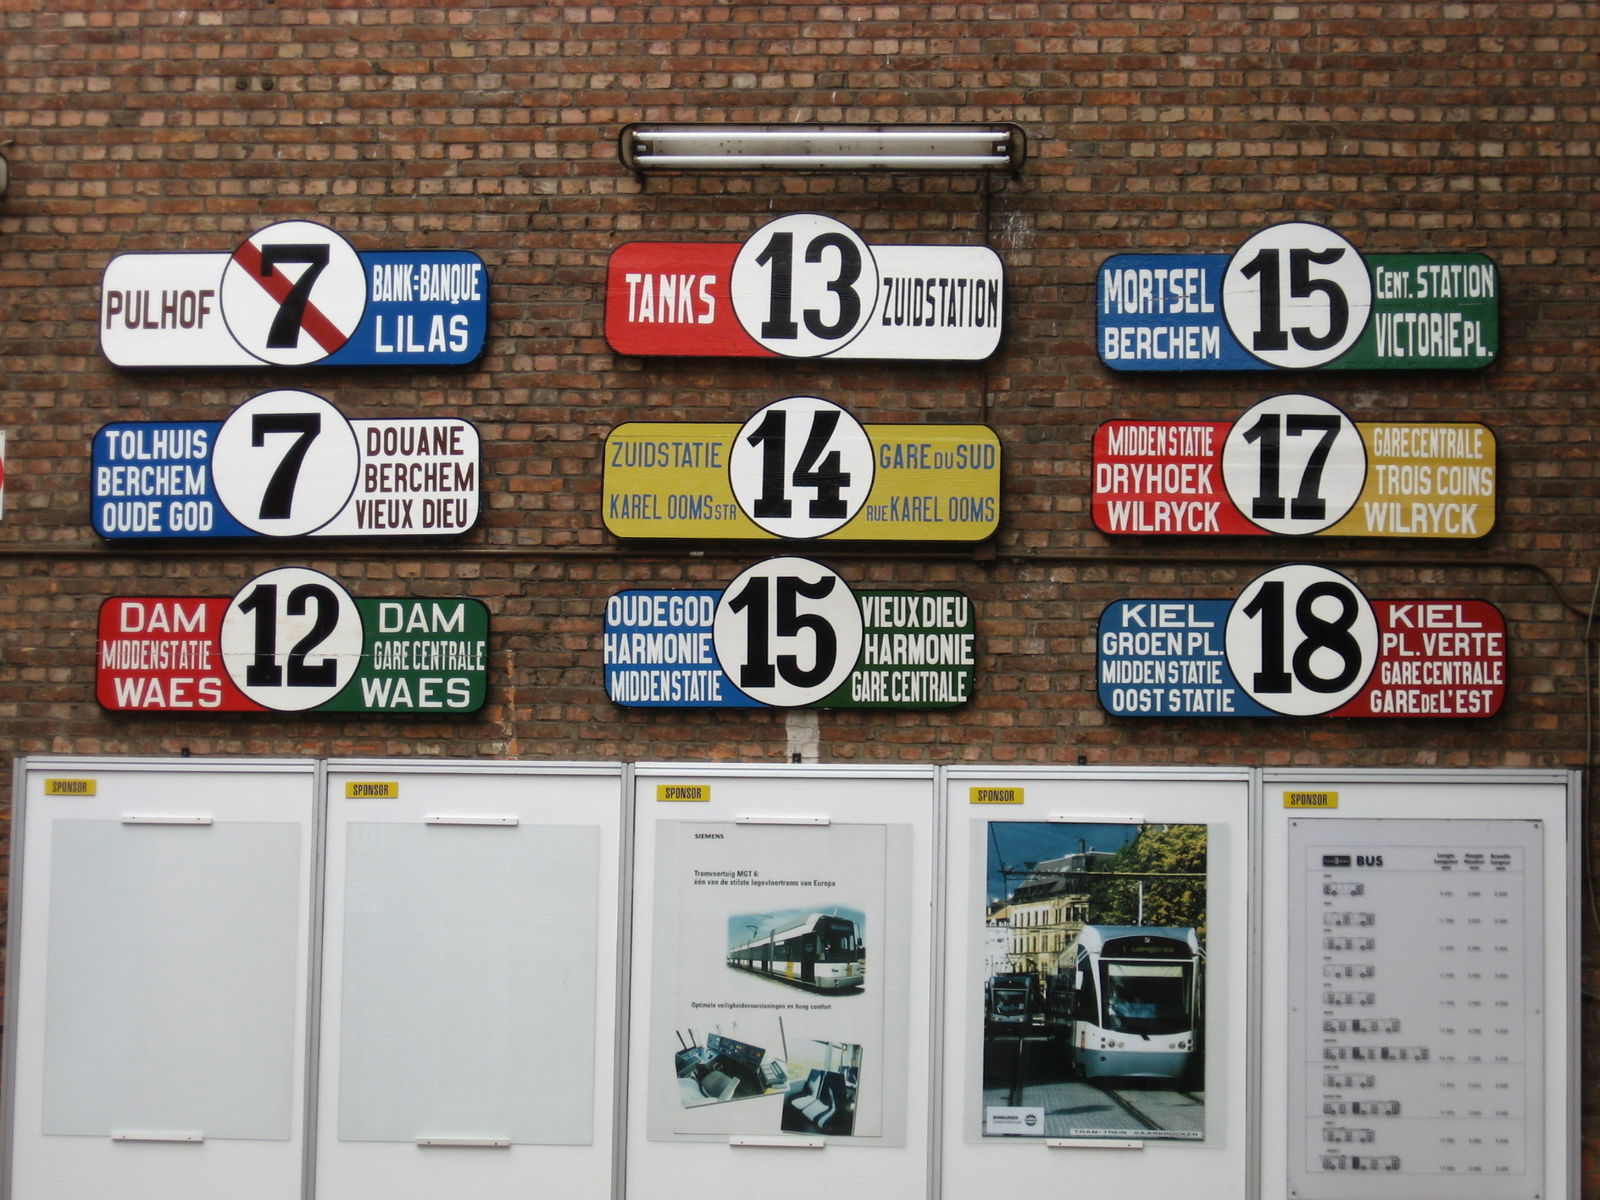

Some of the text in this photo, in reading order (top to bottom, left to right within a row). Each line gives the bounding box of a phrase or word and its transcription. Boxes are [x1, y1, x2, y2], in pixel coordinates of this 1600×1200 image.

[261, 243, 330, 348] 7
[754, 232, 862, 340] 13
[1104, 268, 1215, 315] MORTSEL
[1416, 265, 1494, 299] STATION
[106, 290, 214, 329] PULHOF
[625, 273, 717, 325] TANKS
[882, 277, 999, 328] ZUIDSTATION
[1240, 248, 1350, 352] 15
[375, 314, 468, 352] LILAS
[1104, 326, 1220, 360] BERCHEM
[106, 429, 207, 460] TOLHUIS
[366, 426, 464, 457] DOUANE
[611, 441, 723, 469] ZUIDSTATIE
[879, 444, 932, 469] GARE
[956, 444, 995, 470] SUD
[1374, 427, 1483, 459] GARE CENTRALE
[251, 412, 321, 520] 7
[365, 462, 474, 493] BERCHEM
[746, 409, 851, 519] 14
[1096, 463, 1213, 495] DRYHOEK
[1242, 413, 1342, 520] 17
[97, 466, 205, 496] BERCHEM
[1375, 464, 1493, 497] TROIS COINS
[103, 501, 213, 532] OUDE GOD
[356, 498, 468, 529] VIEUX DIEU
[610, 494, 662, 520] KAREL
[890, 496, 943, 522] KAREL
[949, 497, 995, 522] OOMS
[1107, 501, 1221, 533] WILRYCK
[1364, 502, 1478, 535] WILRYCK
[120, 602, 206, 633] DAM
[379, 602, 465, 634] DAM
[861, 596, 969, 628] VIEUX DIEU
[1122, 604, 1215, 628] KIEL
[1389, 604, 1482, 628] KIEL
[238, 583, 340, 687] 12
[728, 576, 837, 688] 15
[1102, 632, 1224, 656] GROEN PL.
[1242, 581, 1362, 694] 18
[1423, 633, 1503, 657] VERTE
[102, 640, 212, 671] MIDDENSTATIE
[374, 640, 485, 671] GARE CENTRALE
[603, 633, 713, 665] HARMONIE
[865, 633, 975, 665] HARMONIE
[852, 671, 967, 703] GARE CENTRALE
[1381, 661, 1503, 685] GARE CENTRALE
[114, 677, 222, 708] WAES
[361, 677, 471, 708] WAES
[1112, 689, 1235, 713] OOST STATIE
[1370, 689, 1420, 713] GARE
[52, 781, 88, 794] SPONSOR
[352, 783, 389, 796] SPONSOR
[665, 787, 702, 799] SPONSOR
[977, 790, 1015, 802] SPONSOR
[1290, 794, 1328, 806] SPONSOR
[694, 870, 736, 878] Tramvoertuig
[1356, 855, 1384, 867] BUS
[813, 880, 836, 888] Europa
